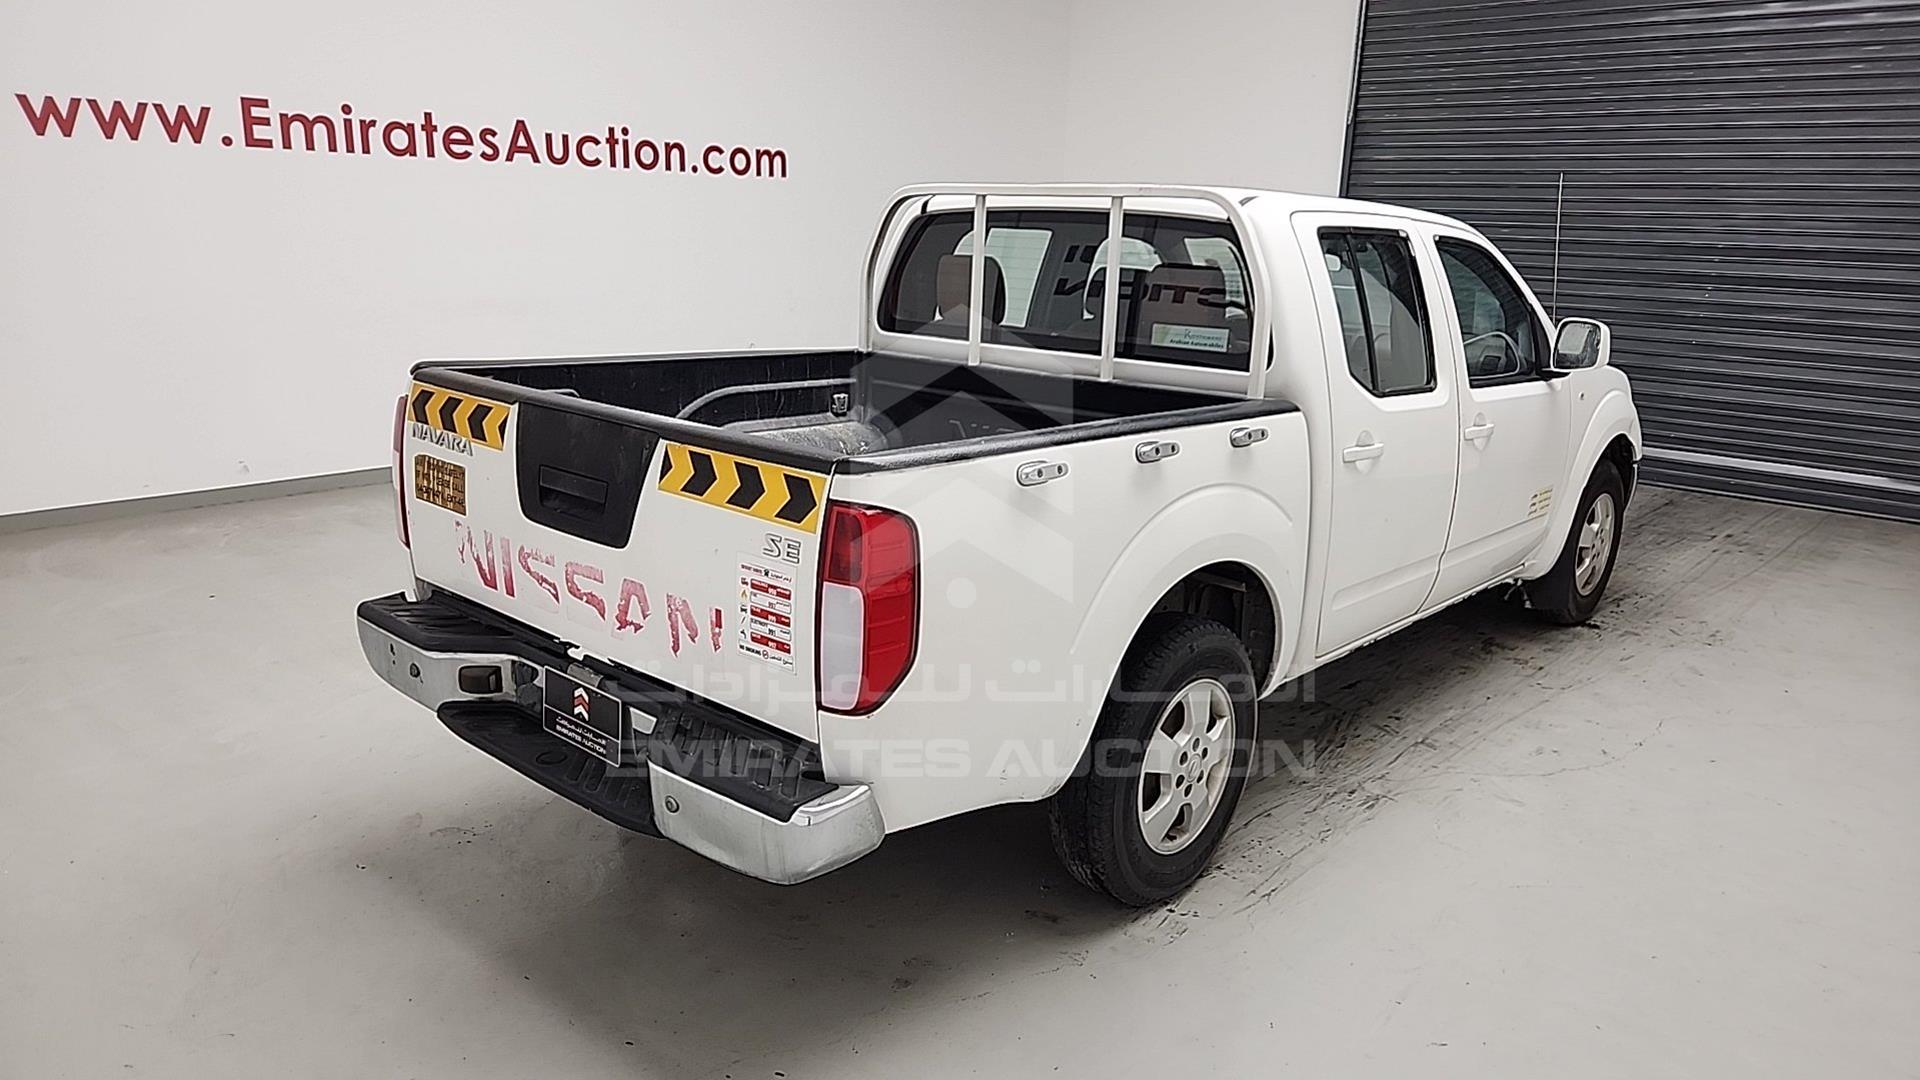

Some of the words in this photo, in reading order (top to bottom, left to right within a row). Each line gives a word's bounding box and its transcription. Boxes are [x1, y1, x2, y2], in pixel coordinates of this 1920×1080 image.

[14, 92, 788, 178] www.EmiratesAuction.com
[412, 422, 474, 457] NAVARA
[762, 532, 802, 565] SE
[556, 724, 582, 742] EMIRATES
[581, 738, 606, 755] AUCTION
